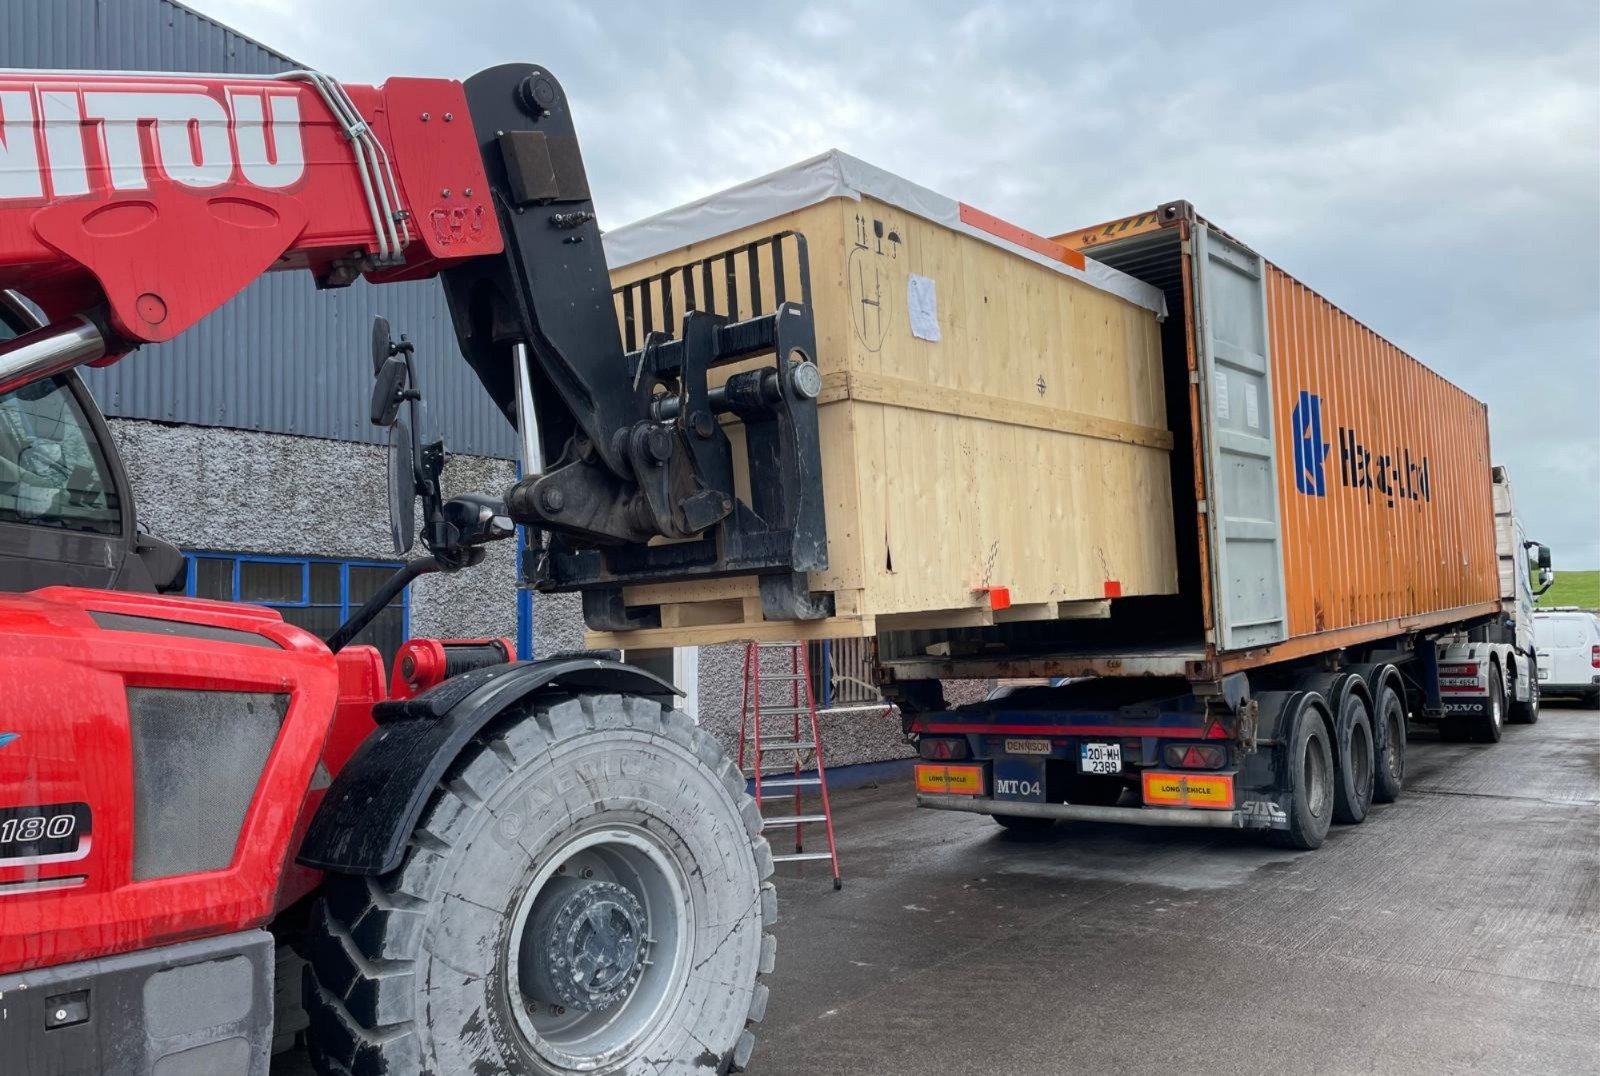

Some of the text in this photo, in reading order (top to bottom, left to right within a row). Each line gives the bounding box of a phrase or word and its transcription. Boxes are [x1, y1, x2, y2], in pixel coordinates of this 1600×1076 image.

[1442, 703, 1483, 712] OLVO
[1007, 742, 1049, 752] DENNISON
[1088, 748, 1120, 760] 201-MH
[1092, 761, 1117, 773] 2389
[1161, 785, 1181, 793] LONG
[0, 814, 76, 843] 180
